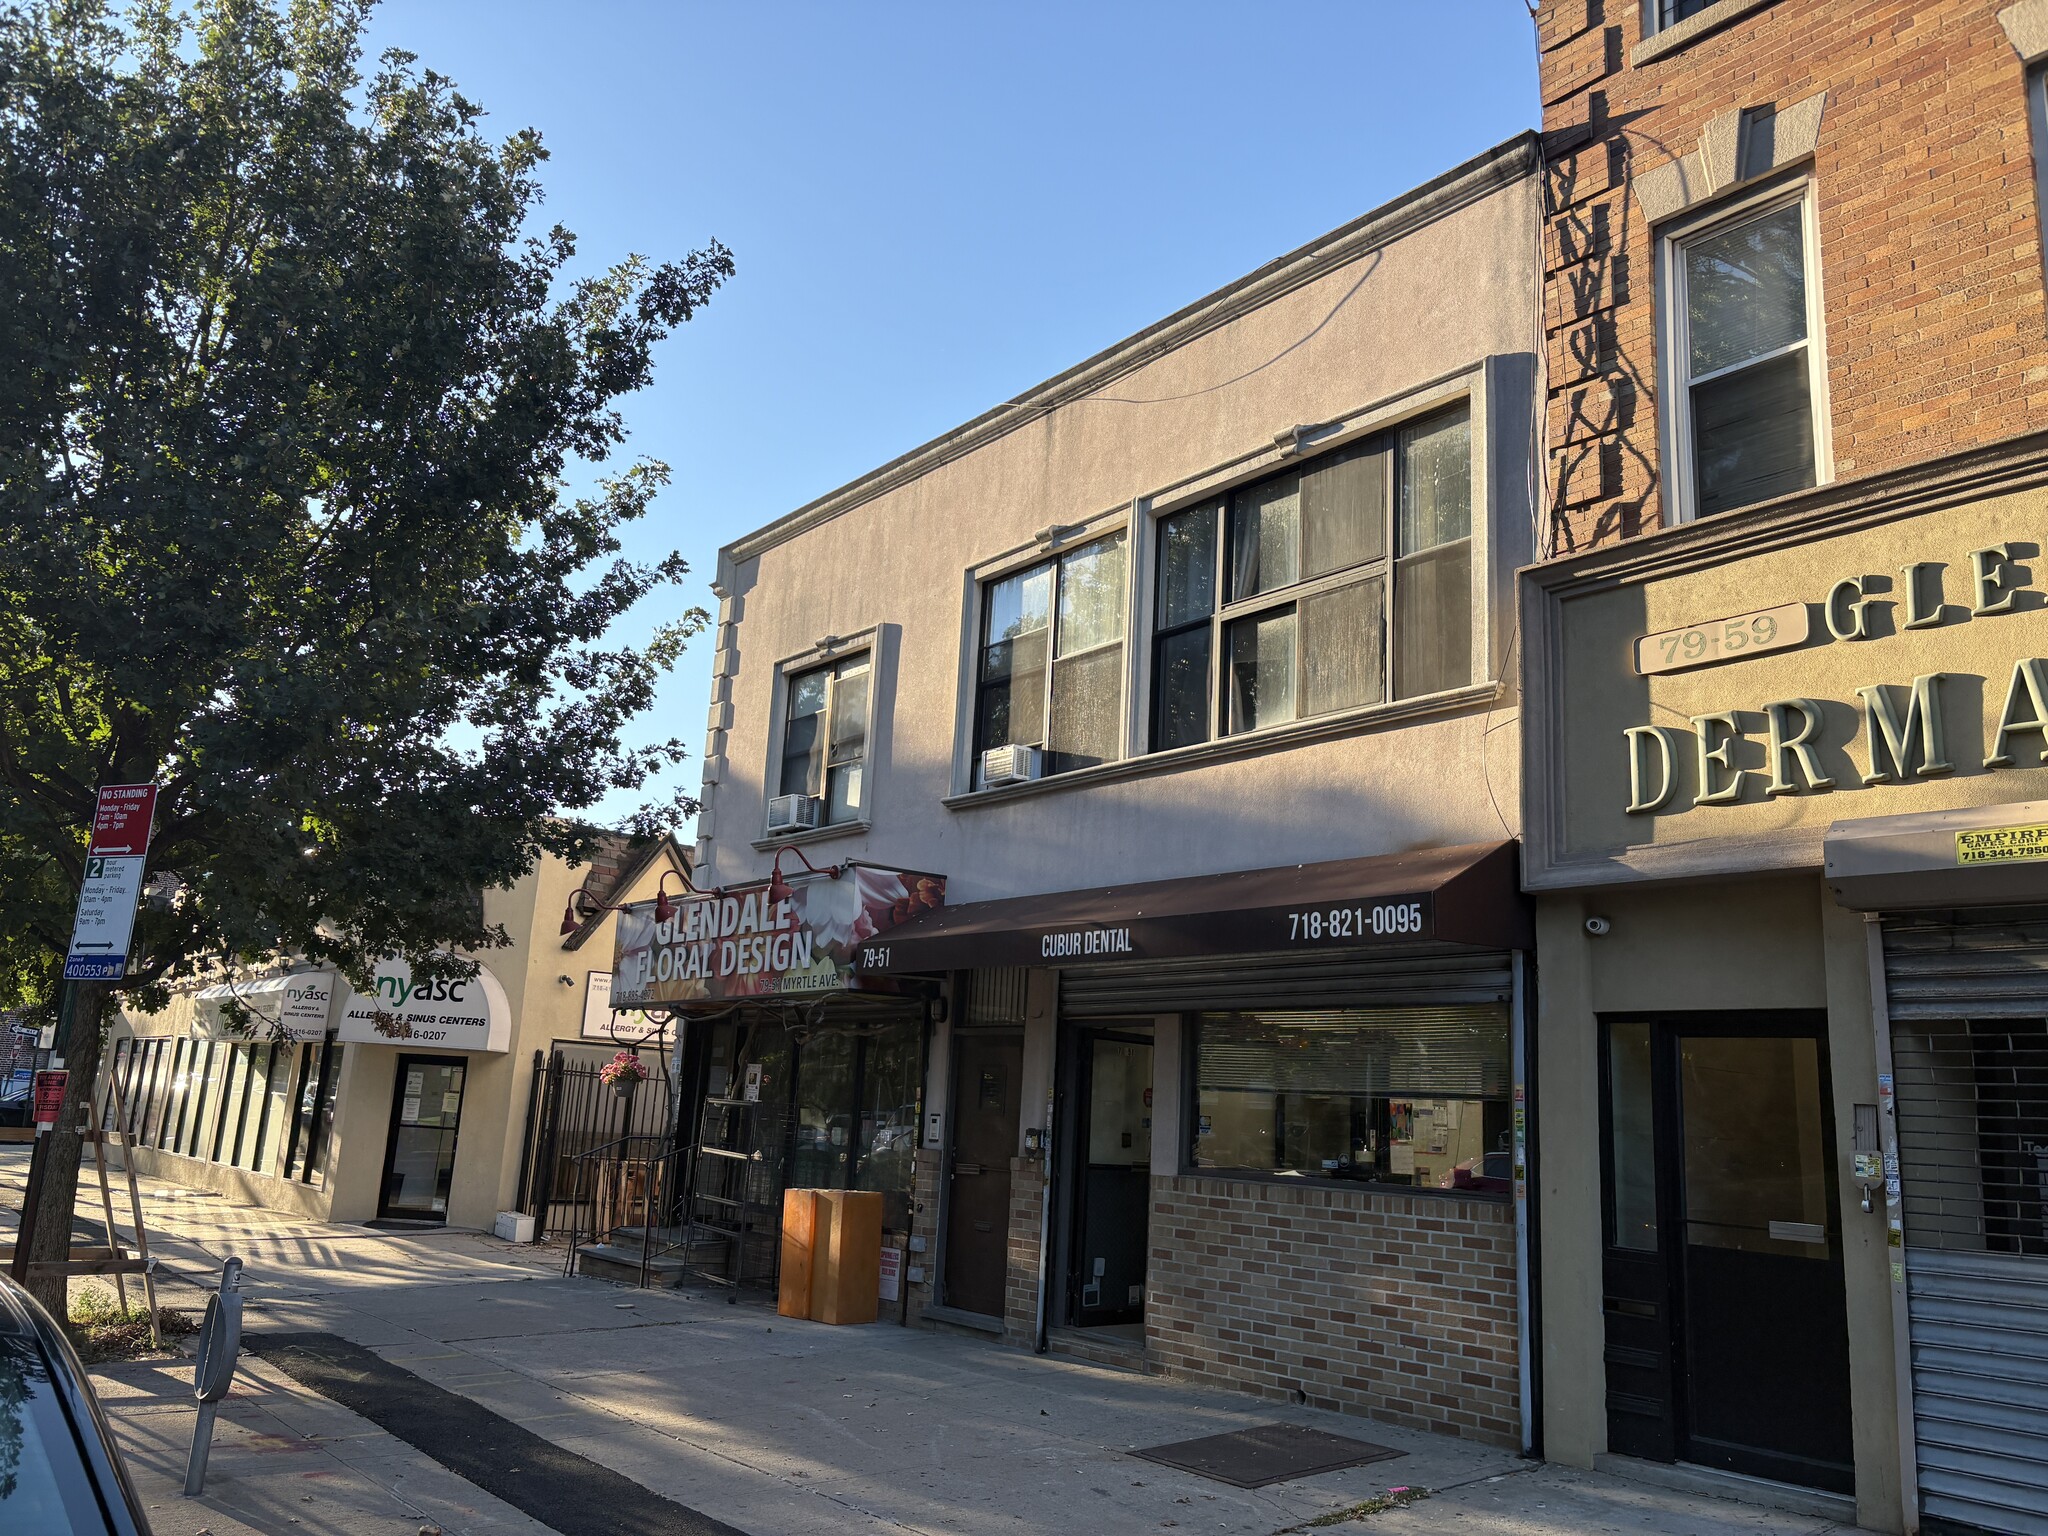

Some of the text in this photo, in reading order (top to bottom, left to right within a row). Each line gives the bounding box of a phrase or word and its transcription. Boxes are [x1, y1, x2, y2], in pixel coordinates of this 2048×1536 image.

[1824, 542, 2048, 642] GLE
[1659, 615, 1777, 664] 79-59
[102, 789, 148, 799] NO STANDING
[124, 803, 140, 811] Friday
[113, 821, 124, 830] 7pm
[1963, 846, 2048, 860] 718-344-7950
[90, 859, 101, 877] 2
[85, 887, 105, 895] Monday
[109, 886, 126, 894] Friday
[80, 909, 104, 917] Saturday
[656, 891, 792, 945] GLENDALE
[1288, 903, 1422, 940] 718-821-0095
[1042, 928, 1133, 958] CUBUR DENTAL
[636, 930, 813, 984] FLORAL DESIGN
[863, 947, 891, 968] 79-51
[66, 965, 102, 976] 400553
[782, 975, 817, 990] MYRTLE
[818, 973, 839, 987] AVE.
[287, 985, 328, 1001] nyasc
[377, 976, 466, 1007] nyasc
[348, 1010, 394, 1020] ALLEY
[406, 1014, 436, 1023] SINUS
[439, 1016, 486, 1026] CENTERS
